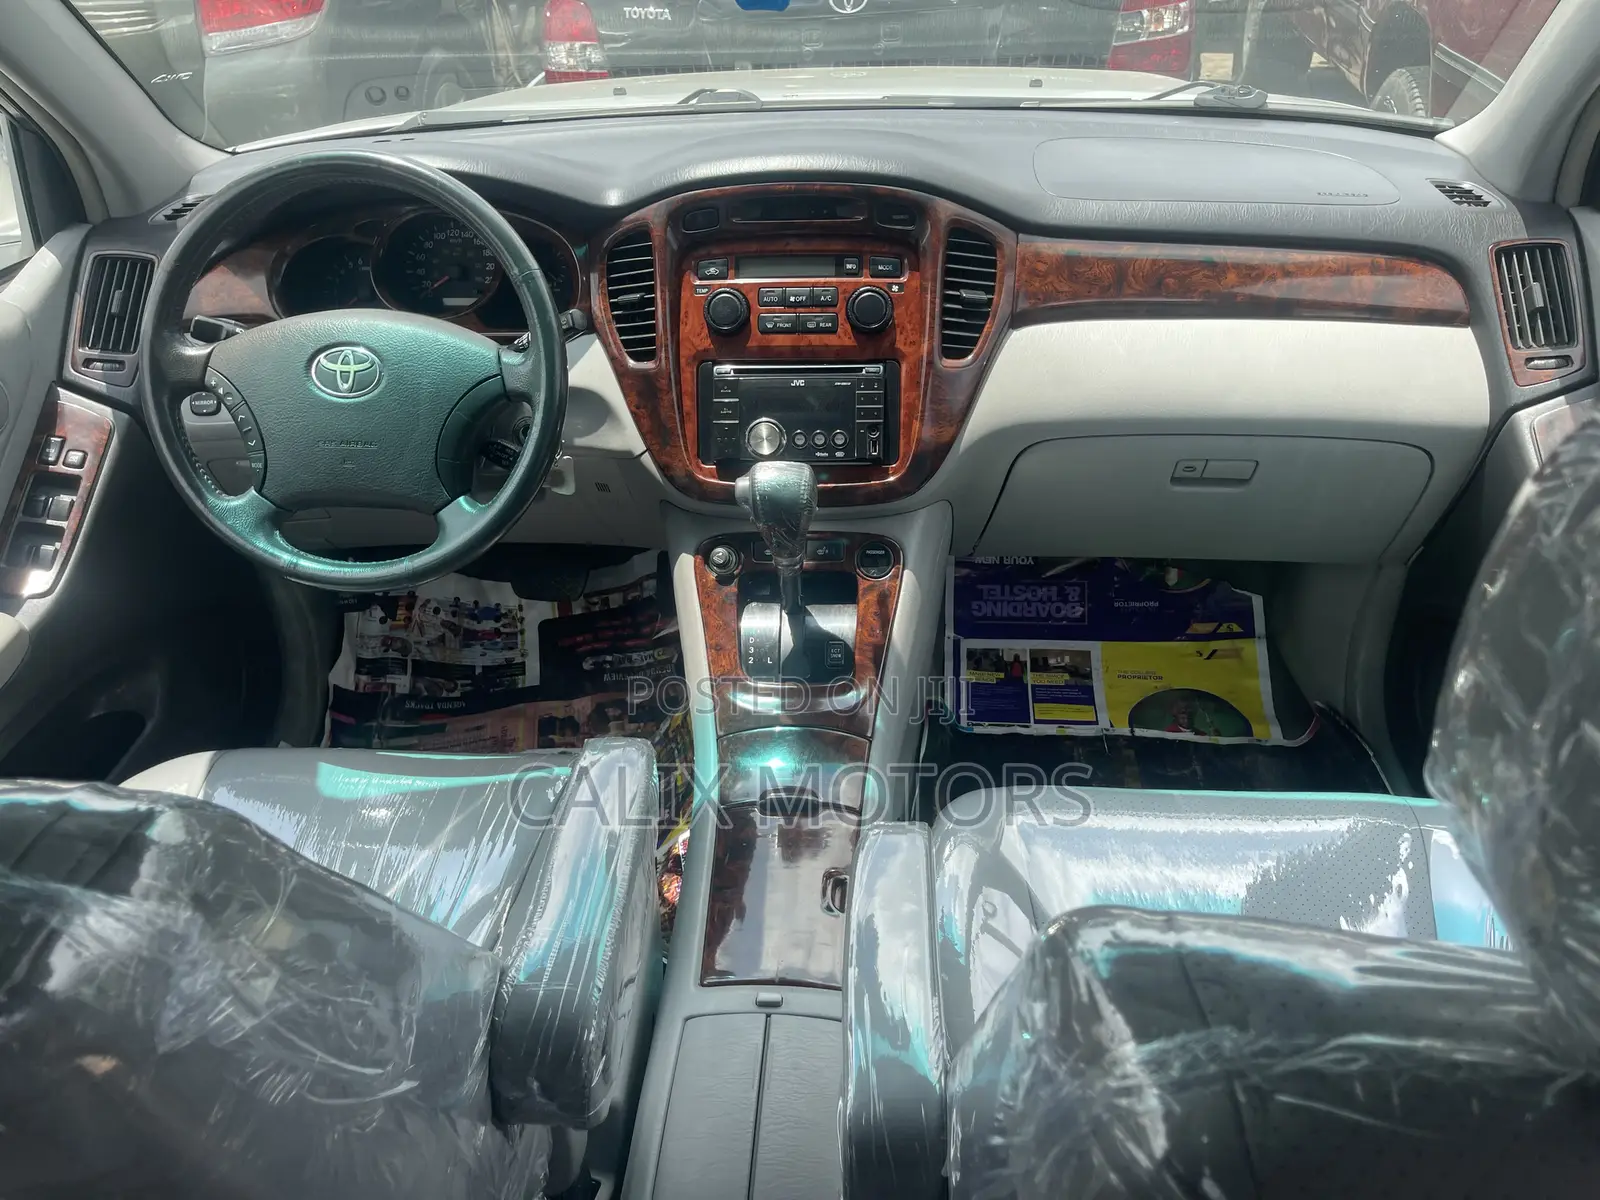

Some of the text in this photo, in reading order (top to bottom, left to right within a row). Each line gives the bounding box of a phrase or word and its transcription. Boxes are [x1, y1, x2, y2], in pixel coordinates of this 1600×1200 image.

[623, 6, 672, 20] TOYOTA
[433, 231, 446, 240] 100
[447, 229, 460, 237] 120
[461, 231, 474, 239] 140
[423, 241, 434, 249] 80
[415, 253, 426, 261] 60
[974, 556, 1035, 565] YOUR NEW
[975, 584, 1081, 601] & HOSTEL
[1113, 600, 1160, 608] PROPRIETOR
[971, 601, 1084, 618] BOARDING
